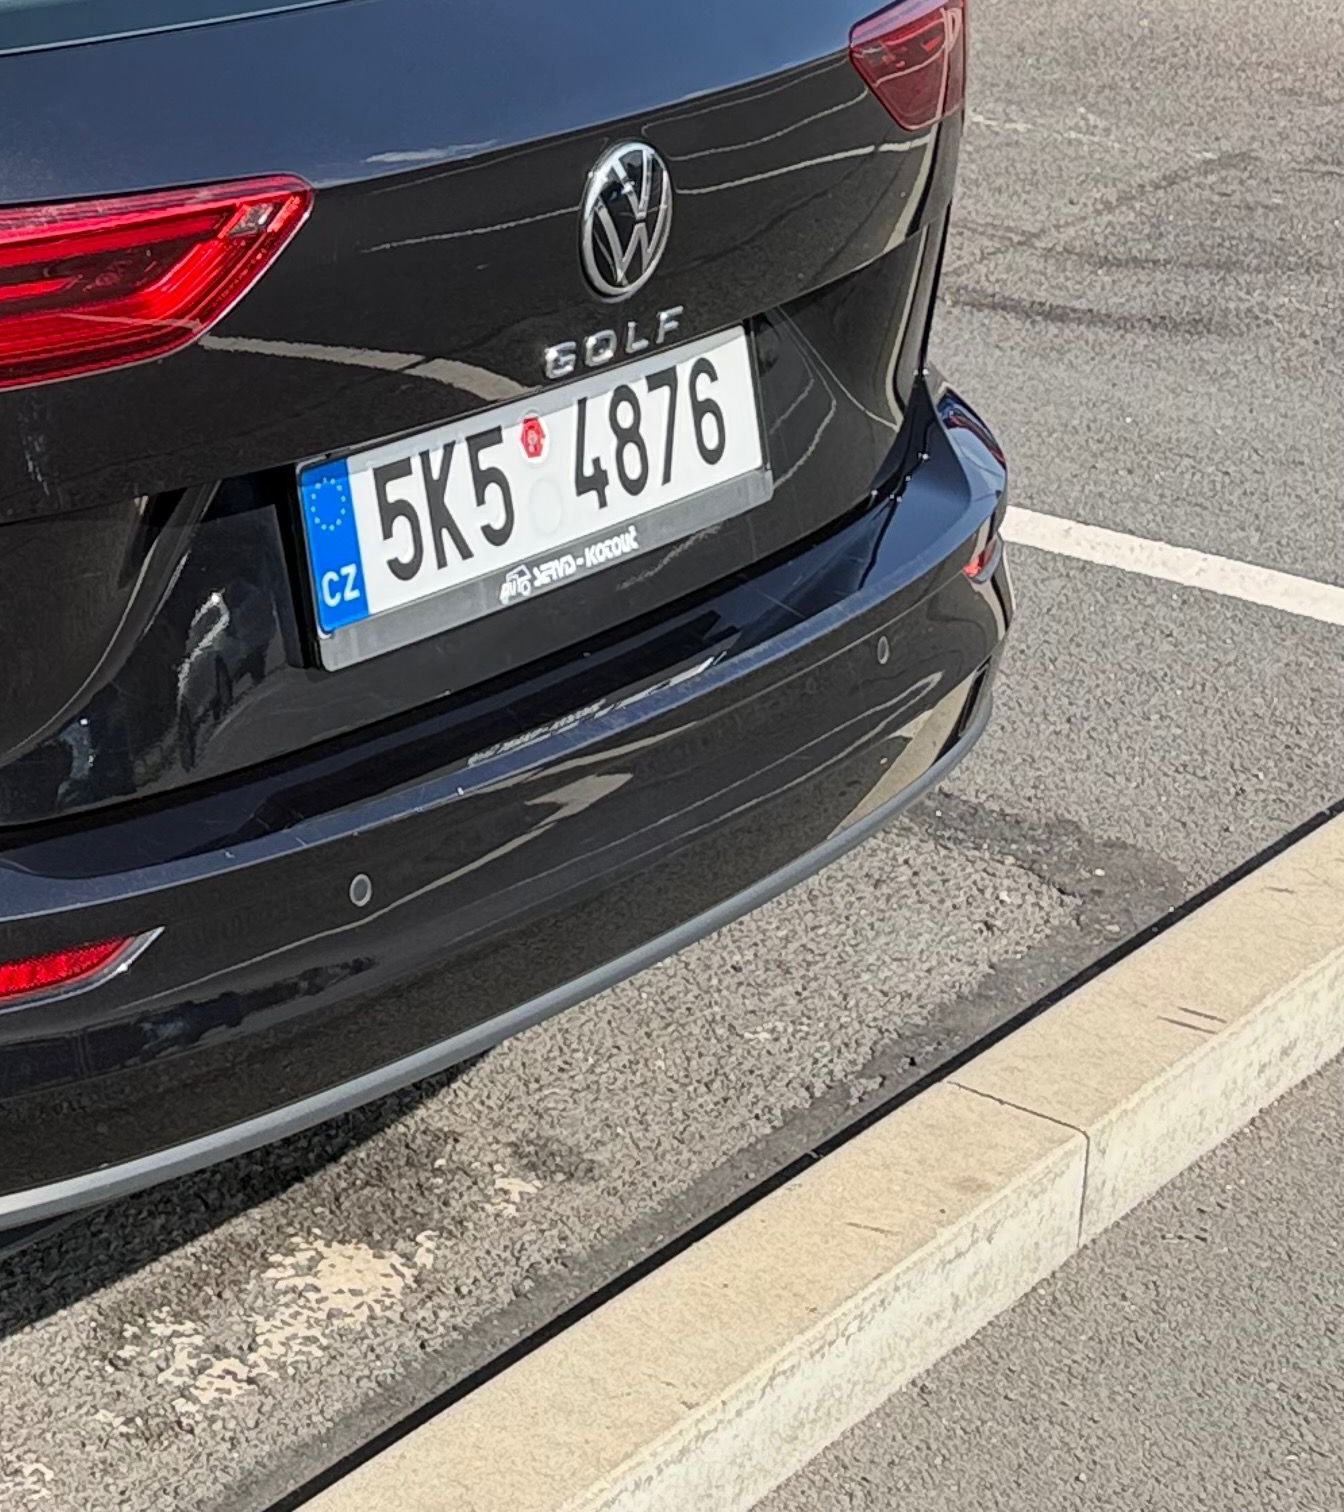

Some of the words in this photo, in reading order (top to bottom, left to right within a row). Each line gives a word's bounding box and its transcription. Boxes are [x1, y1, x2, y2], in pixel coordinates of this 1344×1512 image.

[543, 304, 684, 380] GOLF
[372, 425, 516, 583] 5K5
[574, 357, 727, 511] 4876
[320, 564, 361, 608] CZ
